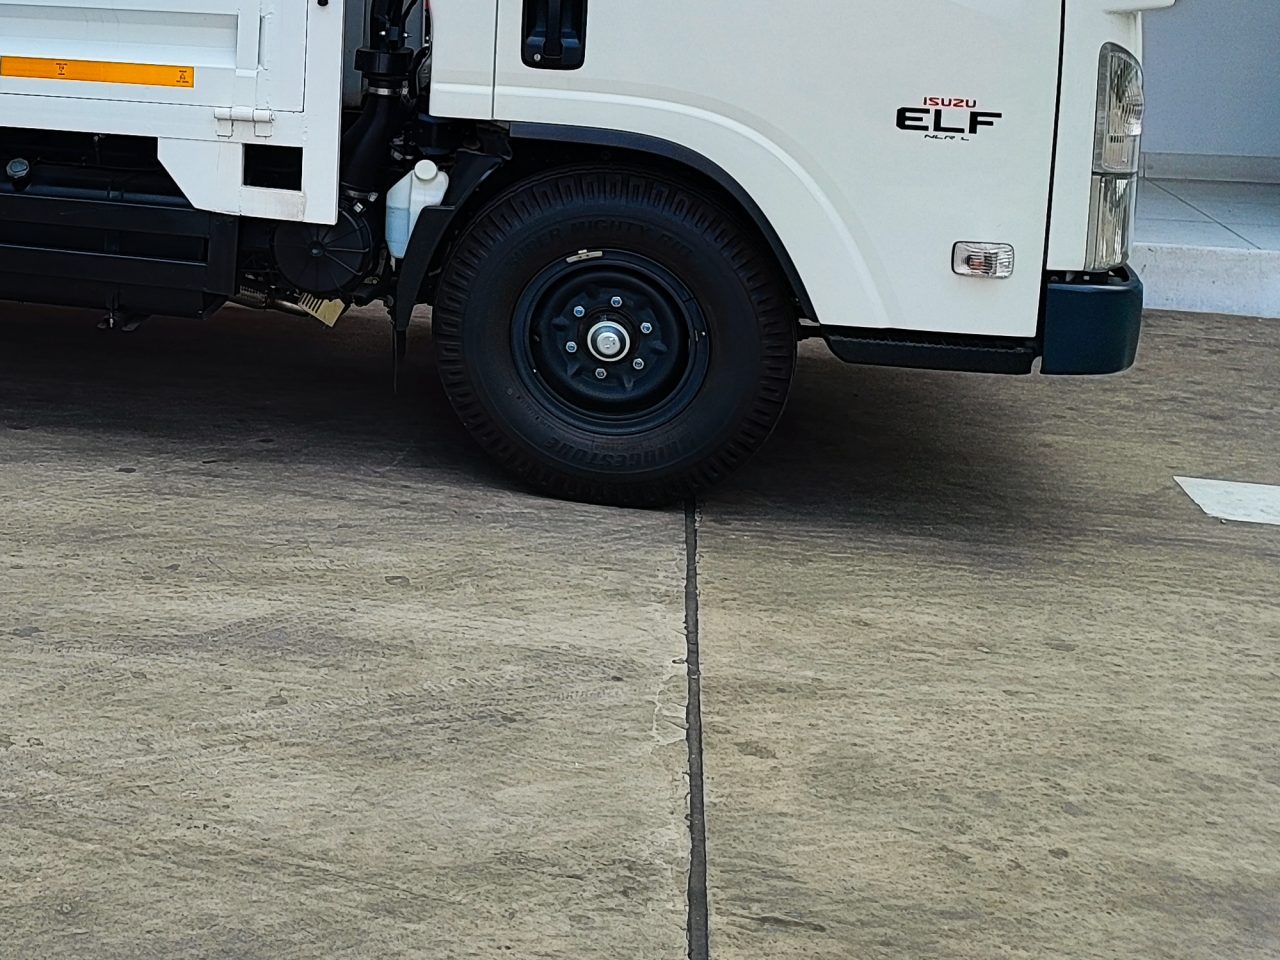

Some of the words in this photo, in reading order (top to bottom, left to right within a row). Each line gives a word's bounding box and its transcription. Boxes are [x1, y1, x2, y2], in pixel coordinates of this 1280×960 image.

[923, 96, 977, 108] ISUZU
[896, 107, 1002, 134] ELF
[570, 218, 651, 236] MIGHTY
